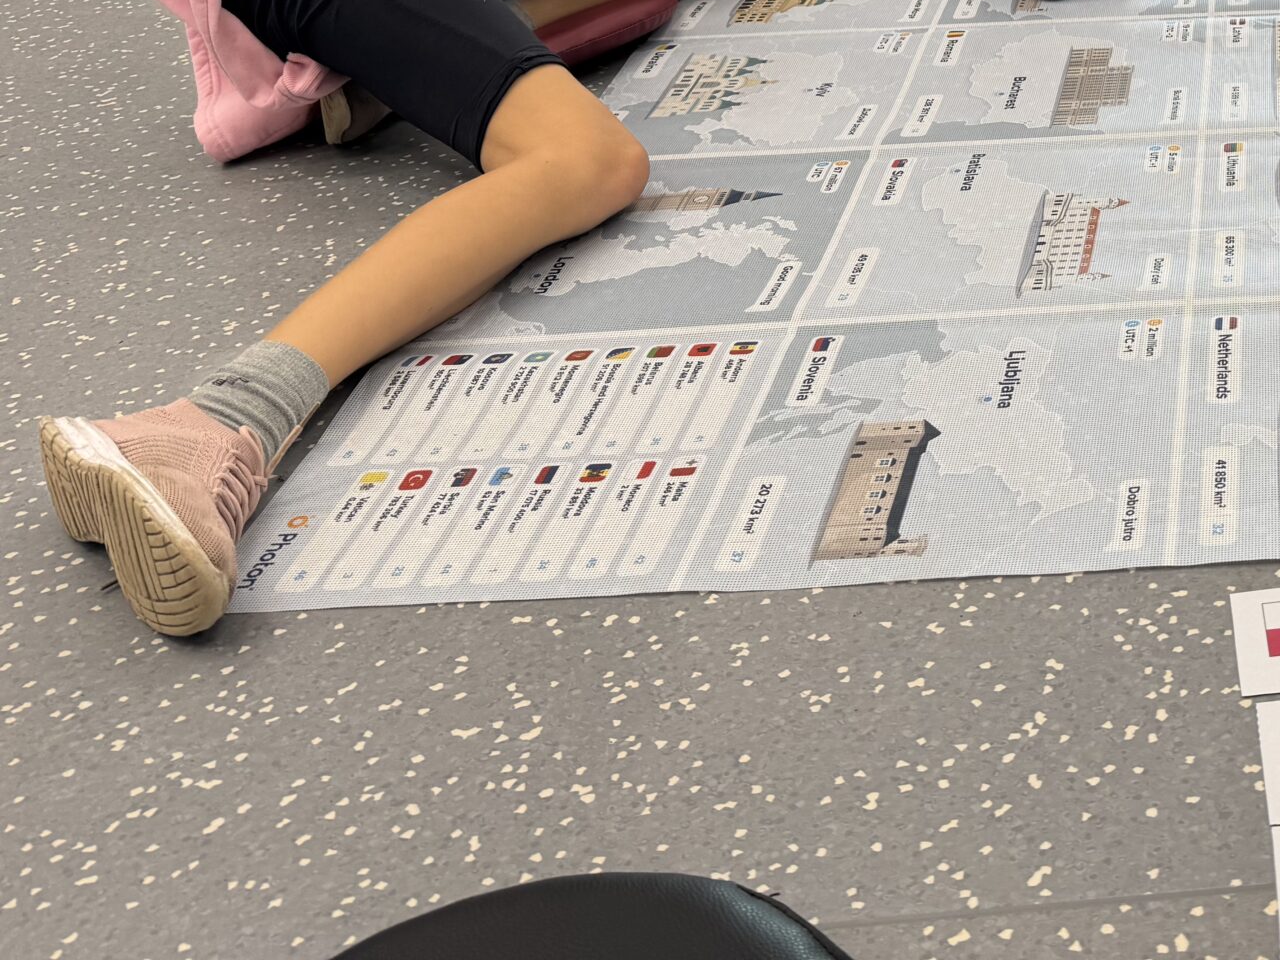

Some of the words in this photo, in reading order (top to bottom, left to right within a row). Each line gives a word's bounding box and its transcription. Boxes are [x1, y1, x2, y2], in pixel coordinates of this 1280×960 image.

[642, 50, 666, 73] Ukraine
[1004, 76, 1026, 109] Bucharest
[960, 153, 985, 191] Bratislava
[1225, 154, 1238, 186] Lithuania
[881, 170, 904, 200] Slovakia
[534, 255, 573, 294] London
[776, 265, 793, 281] Good
[758, 281, 782, 305] morning
[1123, 328, 1136, 344] UTC
[1145, 332, 1157, 357] million
[477, 366, 497, 390] Kosovo
[728, 358, 746, 383] Andorra
[796, 356, 826, 400] Slovenia
[1215, 333, 1232, 398] Netherlands
[597, 384, 608, 397] and
[997, 350, 1025, 408] Ljubljana
[490, 489, 506, 504] San
[530, 488, 551, 511] Russia
[620, 483, 642, 512] Monaco
[671, 481, 688, 501] Malta
[757, 483, 772, 496] 20
[1125, 485, 1140, 516] Dobro
[344, 496, 370, 522] Vatican
[389, 494, 415, 518] Turkey
[438, 491, 460, 515] Serbia
[749, 498, 767, 515] 273
[474, 504, 496, 530] Marino
[1121, 517, 1137, 541] jutro
[233, 533, 296, 590] Photon
